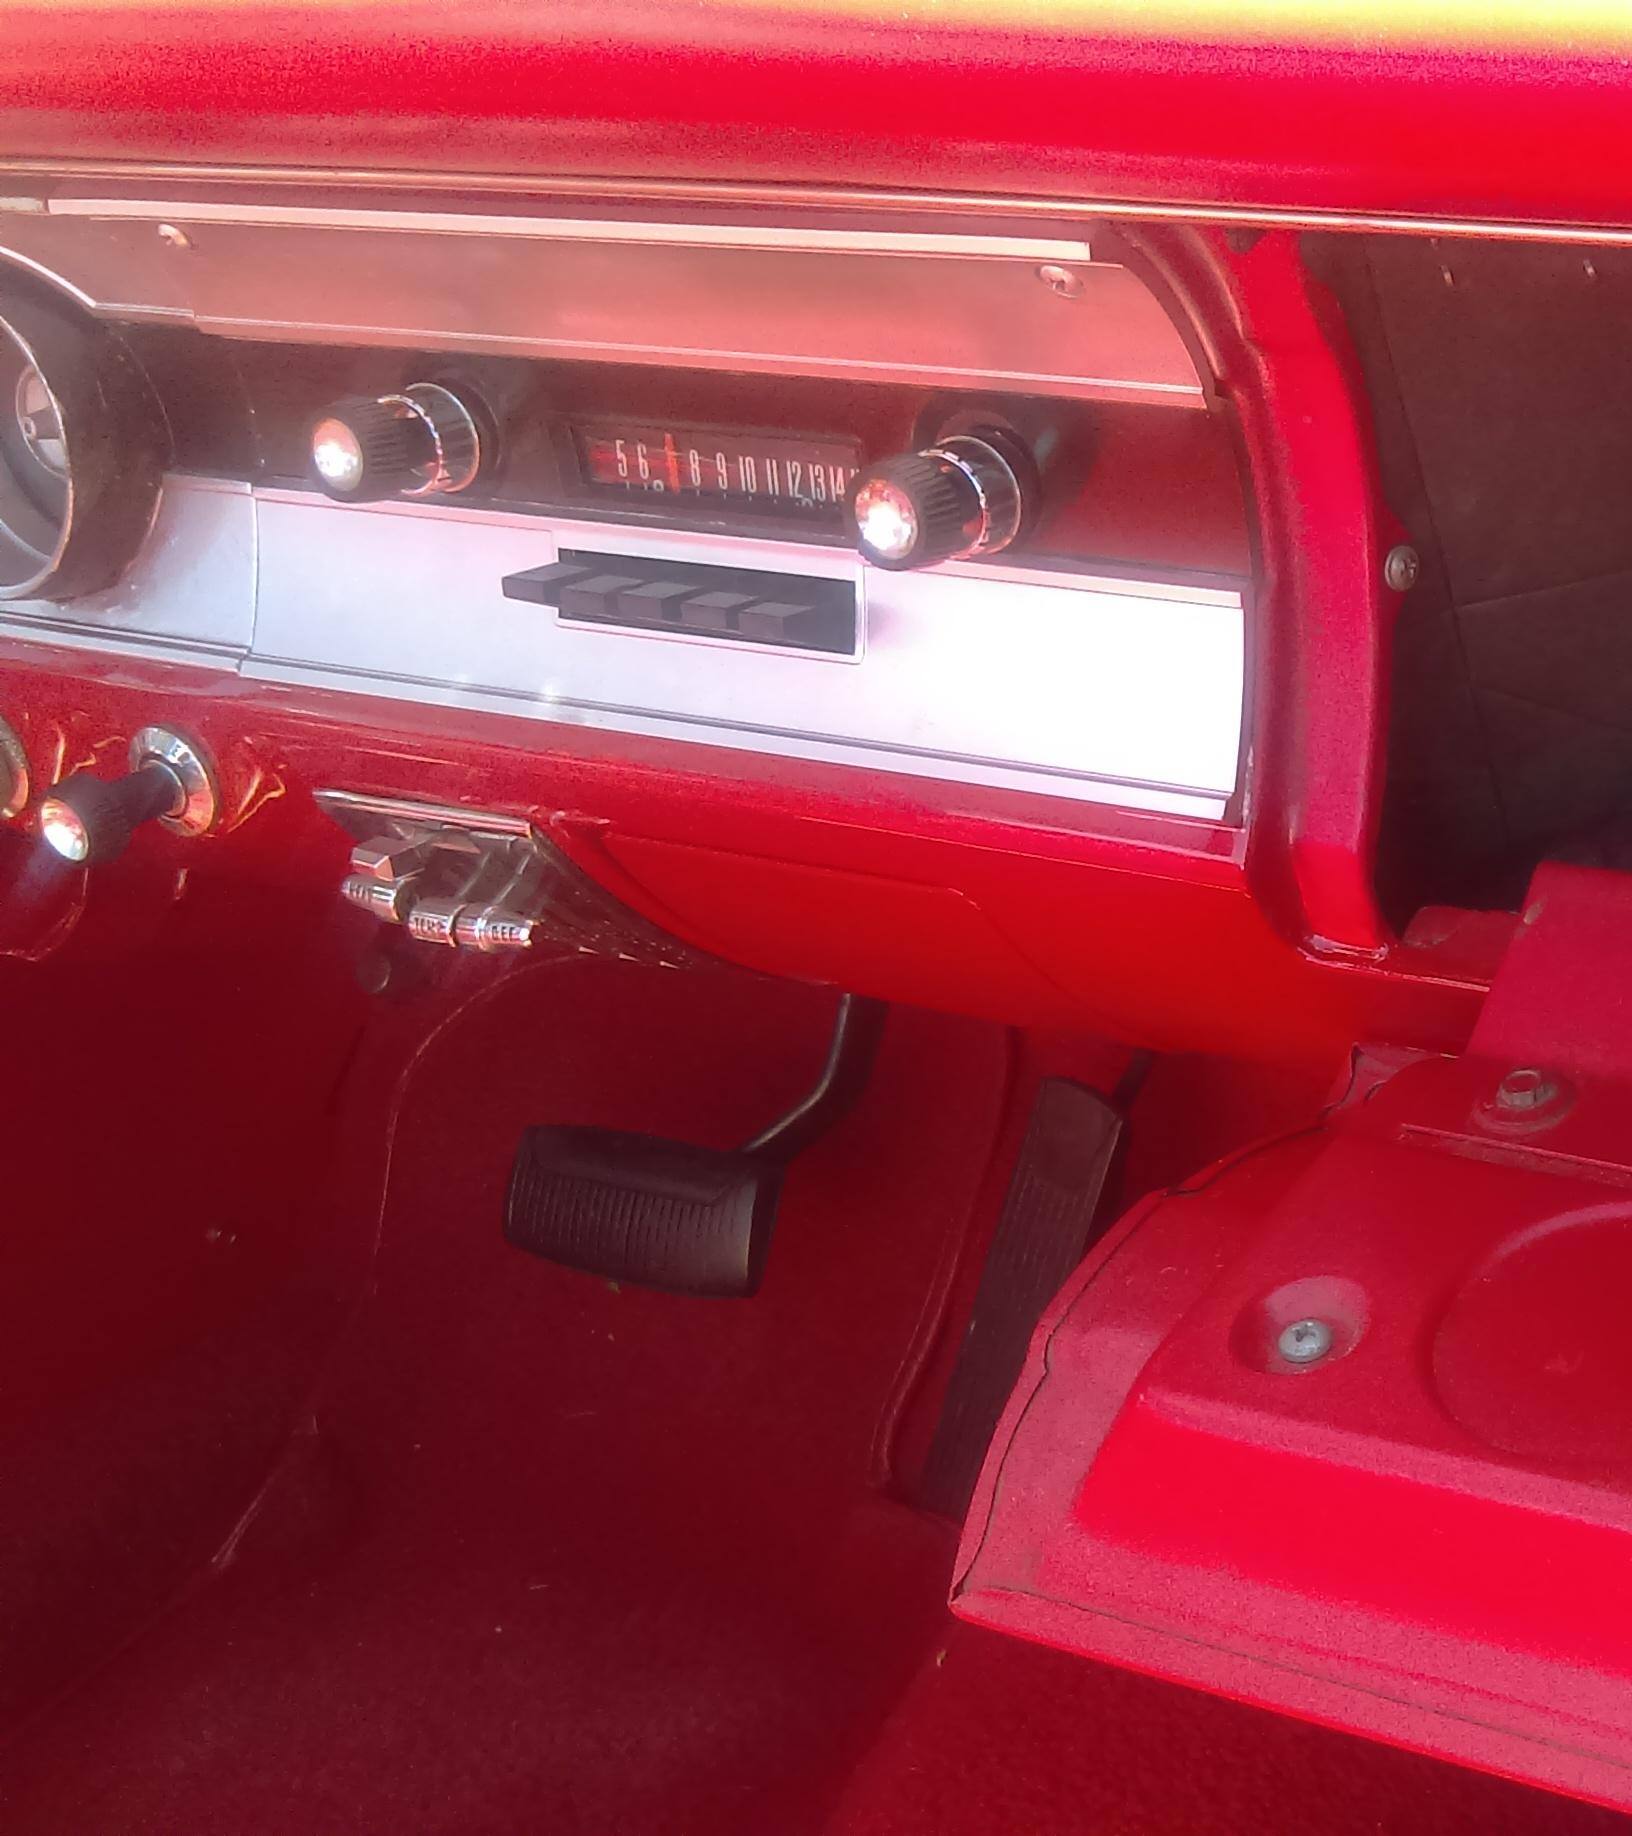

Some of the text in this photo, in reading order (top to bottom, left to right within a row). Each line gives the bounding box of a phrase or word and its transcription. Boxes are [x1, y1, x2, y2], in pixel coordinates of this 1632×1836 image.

[615, 439, 846, 503] 5 6 8 9 10 11 12 13 14
